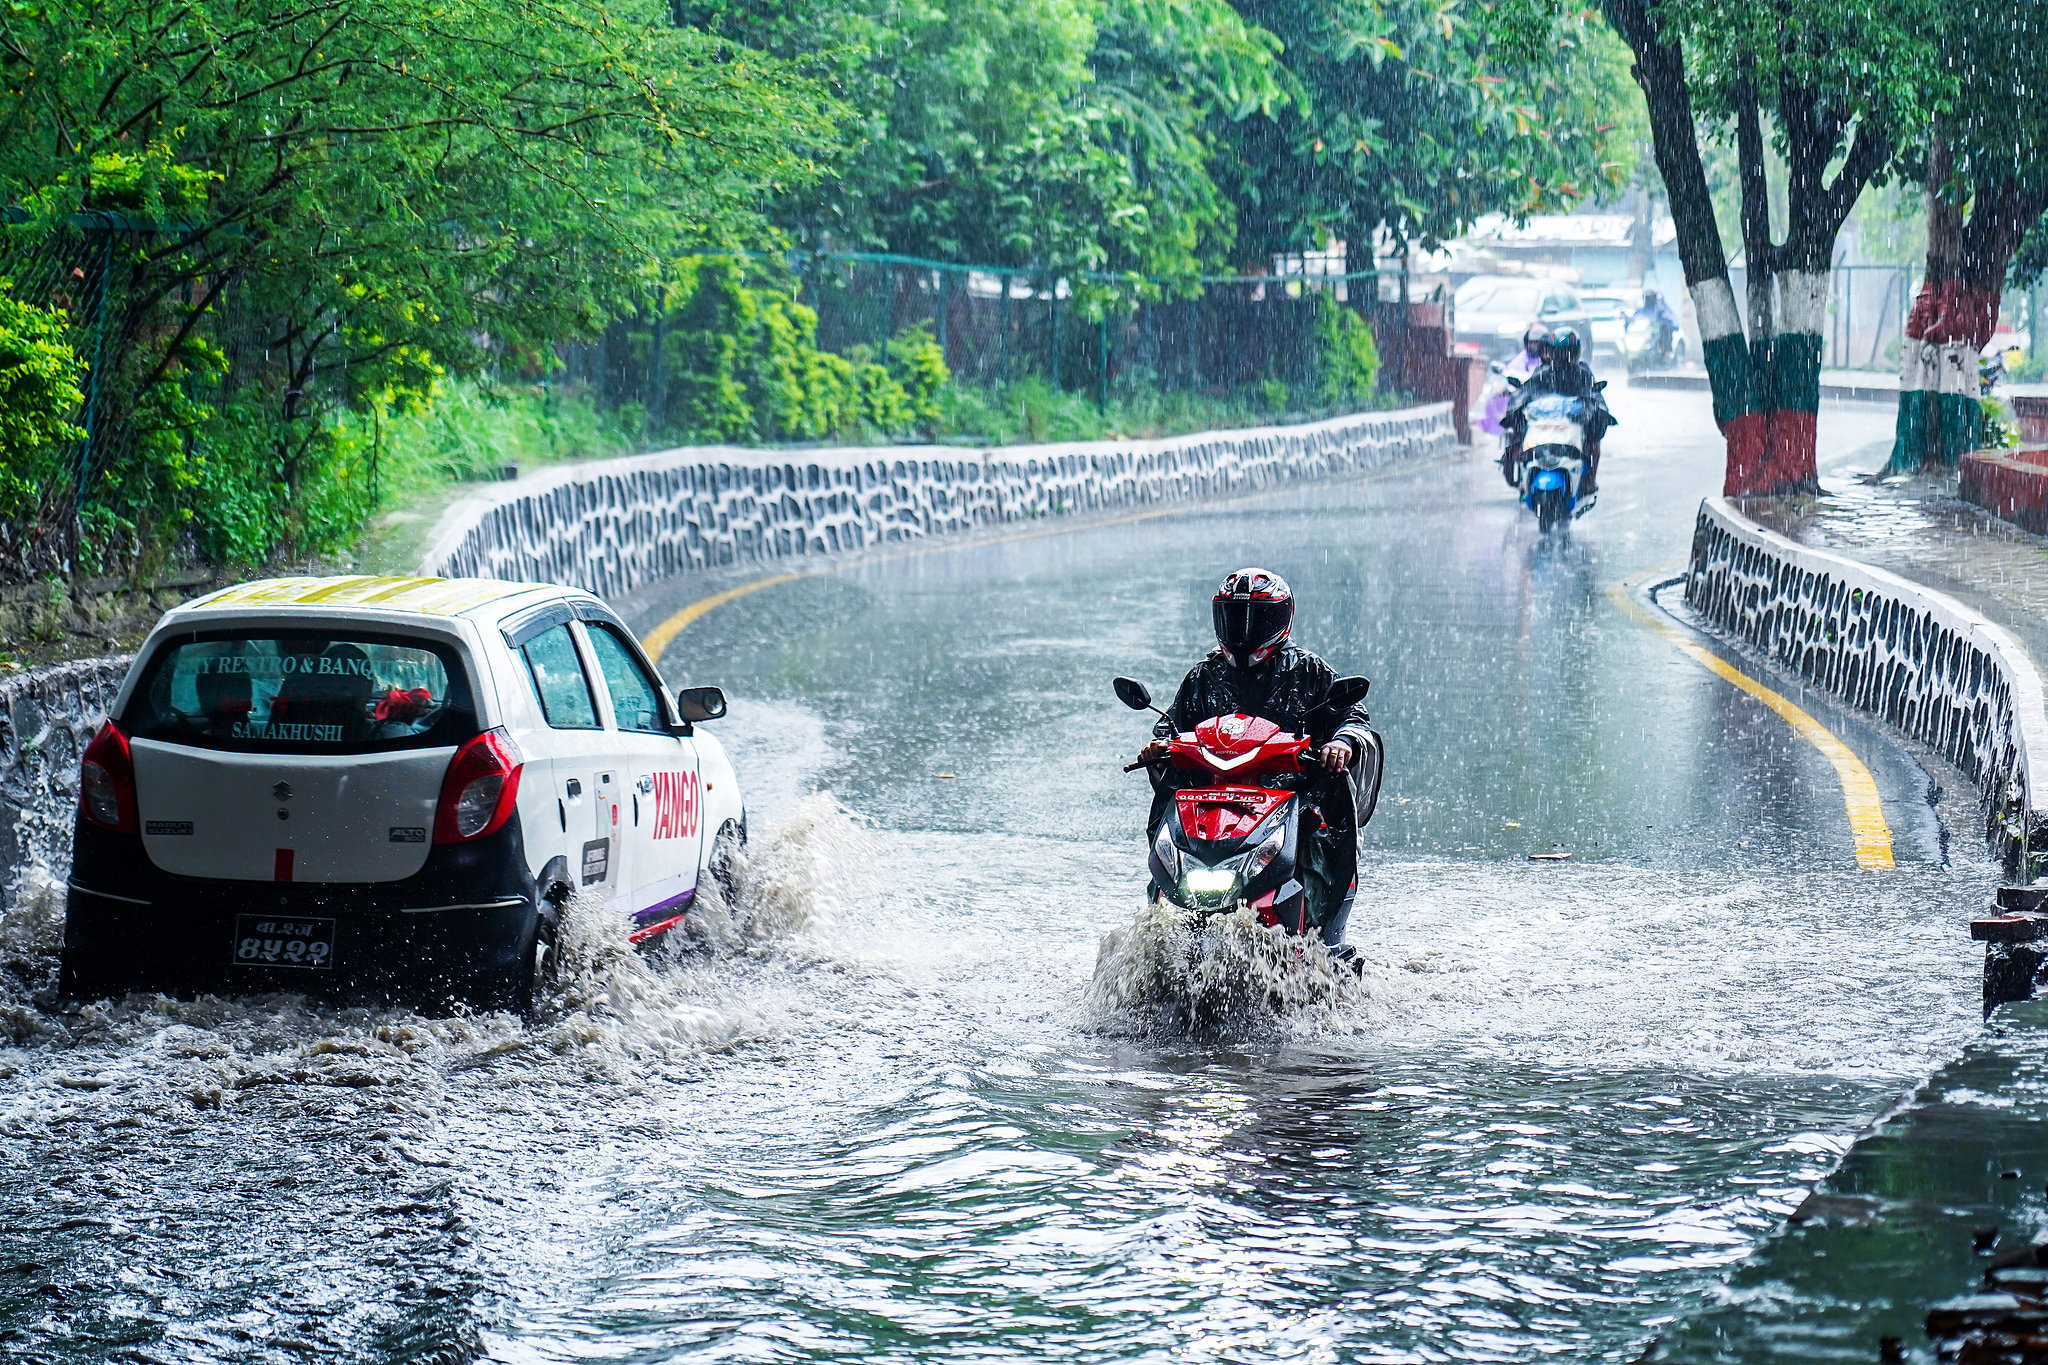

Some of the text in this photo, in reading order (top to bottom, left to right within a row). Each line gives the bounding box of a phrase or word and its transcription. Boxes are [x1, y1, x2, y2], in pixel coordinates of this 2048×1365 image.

[217, 656, 297, 675] RESTRO
[299, 657, 314, 675] &
[231, 721, 343, 742] SAMAKHUSHI
[652, 770, 698, 840] YANGO
[391, 828, 424, 836] ALTO
